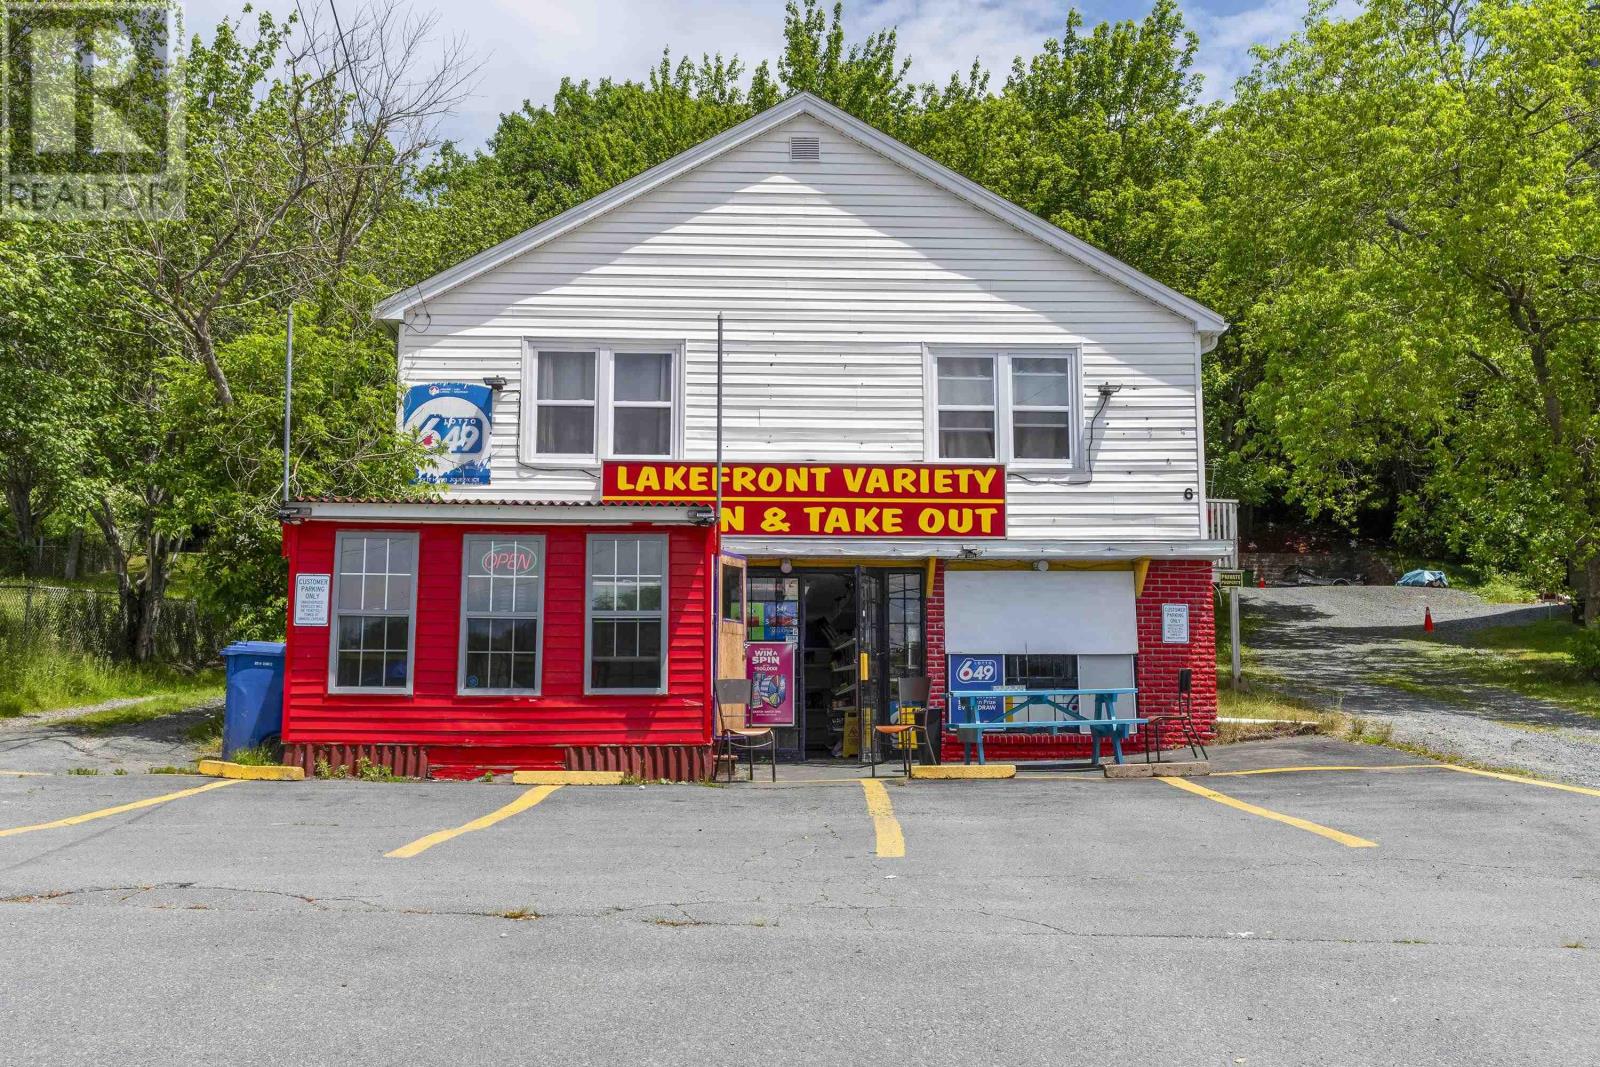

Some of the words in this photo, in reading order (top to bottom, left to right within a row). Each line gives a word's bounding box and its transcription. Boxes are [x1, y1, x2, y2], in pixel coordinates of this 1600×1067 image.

[617, 465, 831, 493] LAKEFRONT
[843, 467, 997, 494] VARIETY
[1183, 488, 1194, 500] 6
[760, 507, 791, 532] &
[803, 507, 903, 534] TAKE
[918, 507, 998, 534] OUT
[484, 552, 532, 570] OPEN
[752, 657, 780, 665] SPIN
